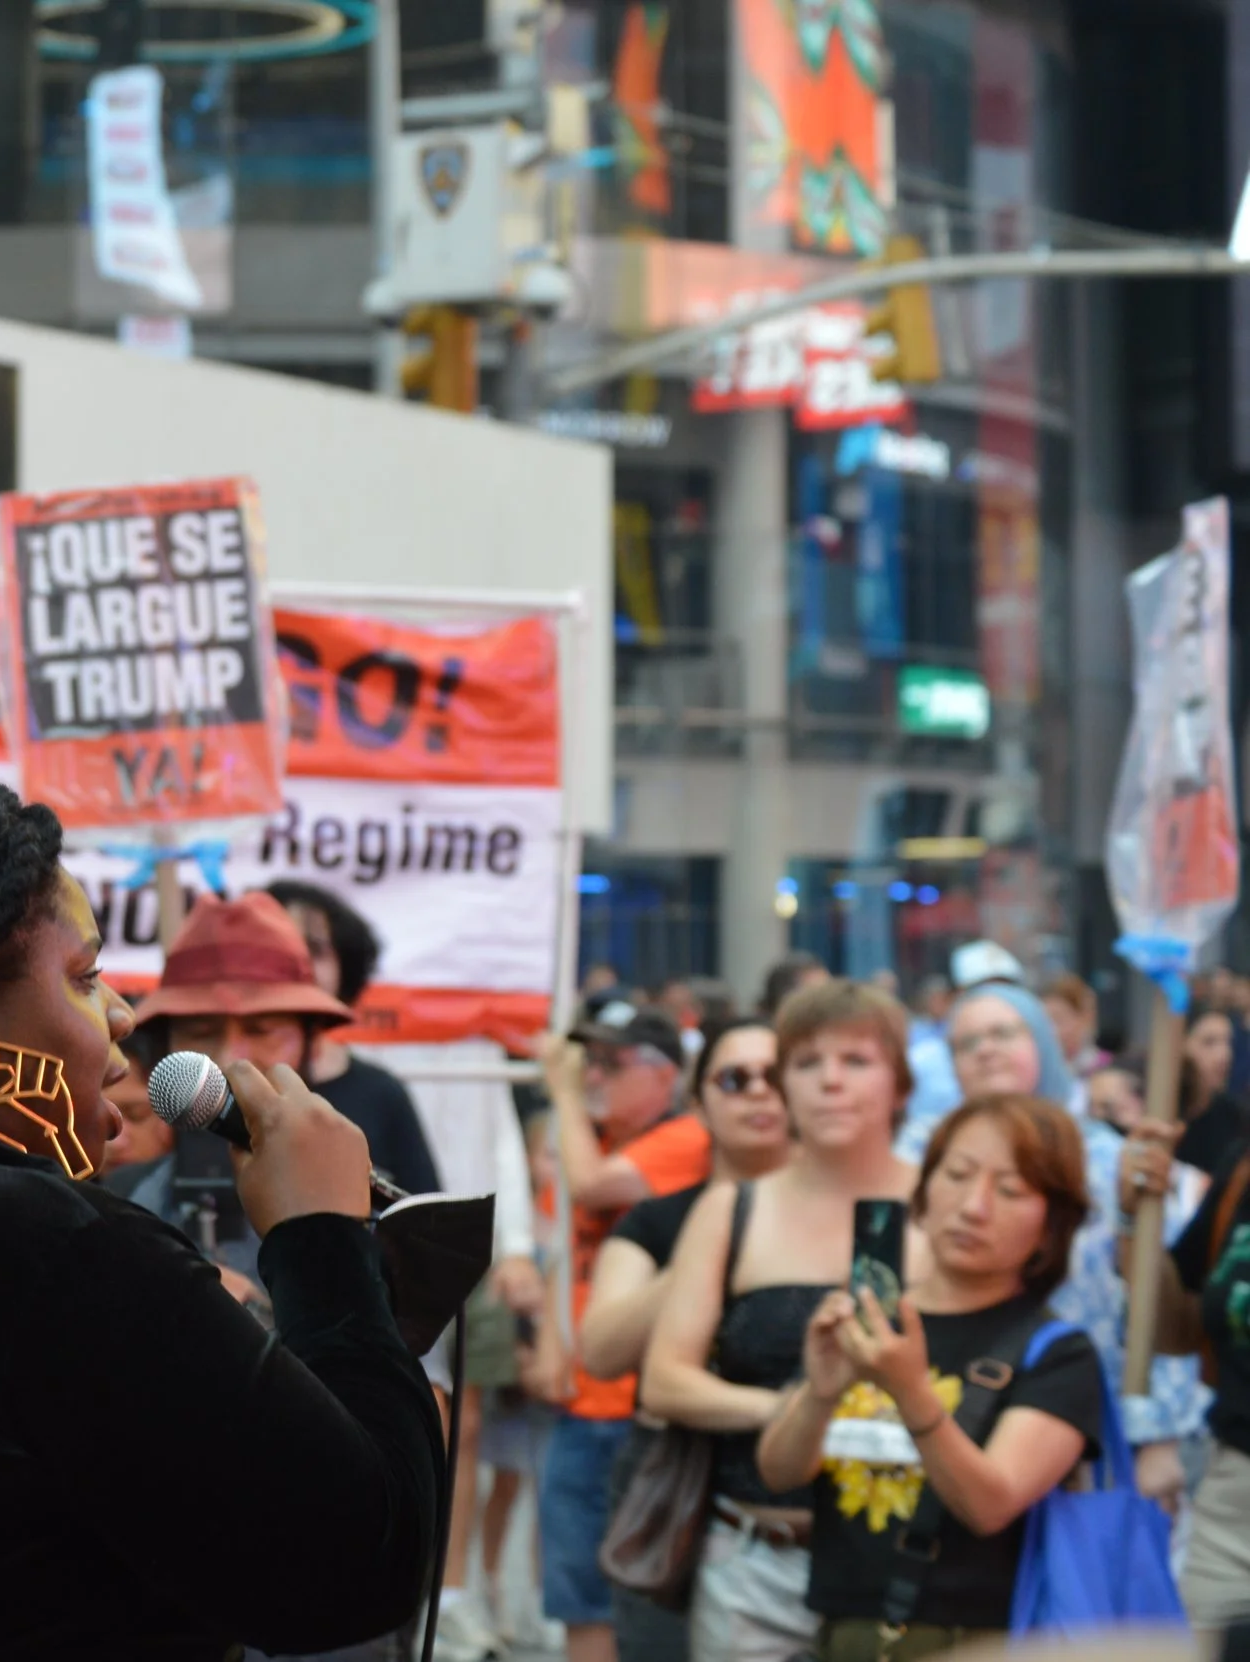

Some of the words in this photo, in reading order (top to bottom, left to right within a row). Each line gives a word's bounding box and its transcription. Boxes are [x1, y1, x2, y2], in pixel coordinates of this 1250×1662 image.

[168, 510, 244, 577] SE
[28, 580, 251, 659] LARGUE
[42, 649, 245, 723] TRUMP
[259, 803, 524, 885] Regime
